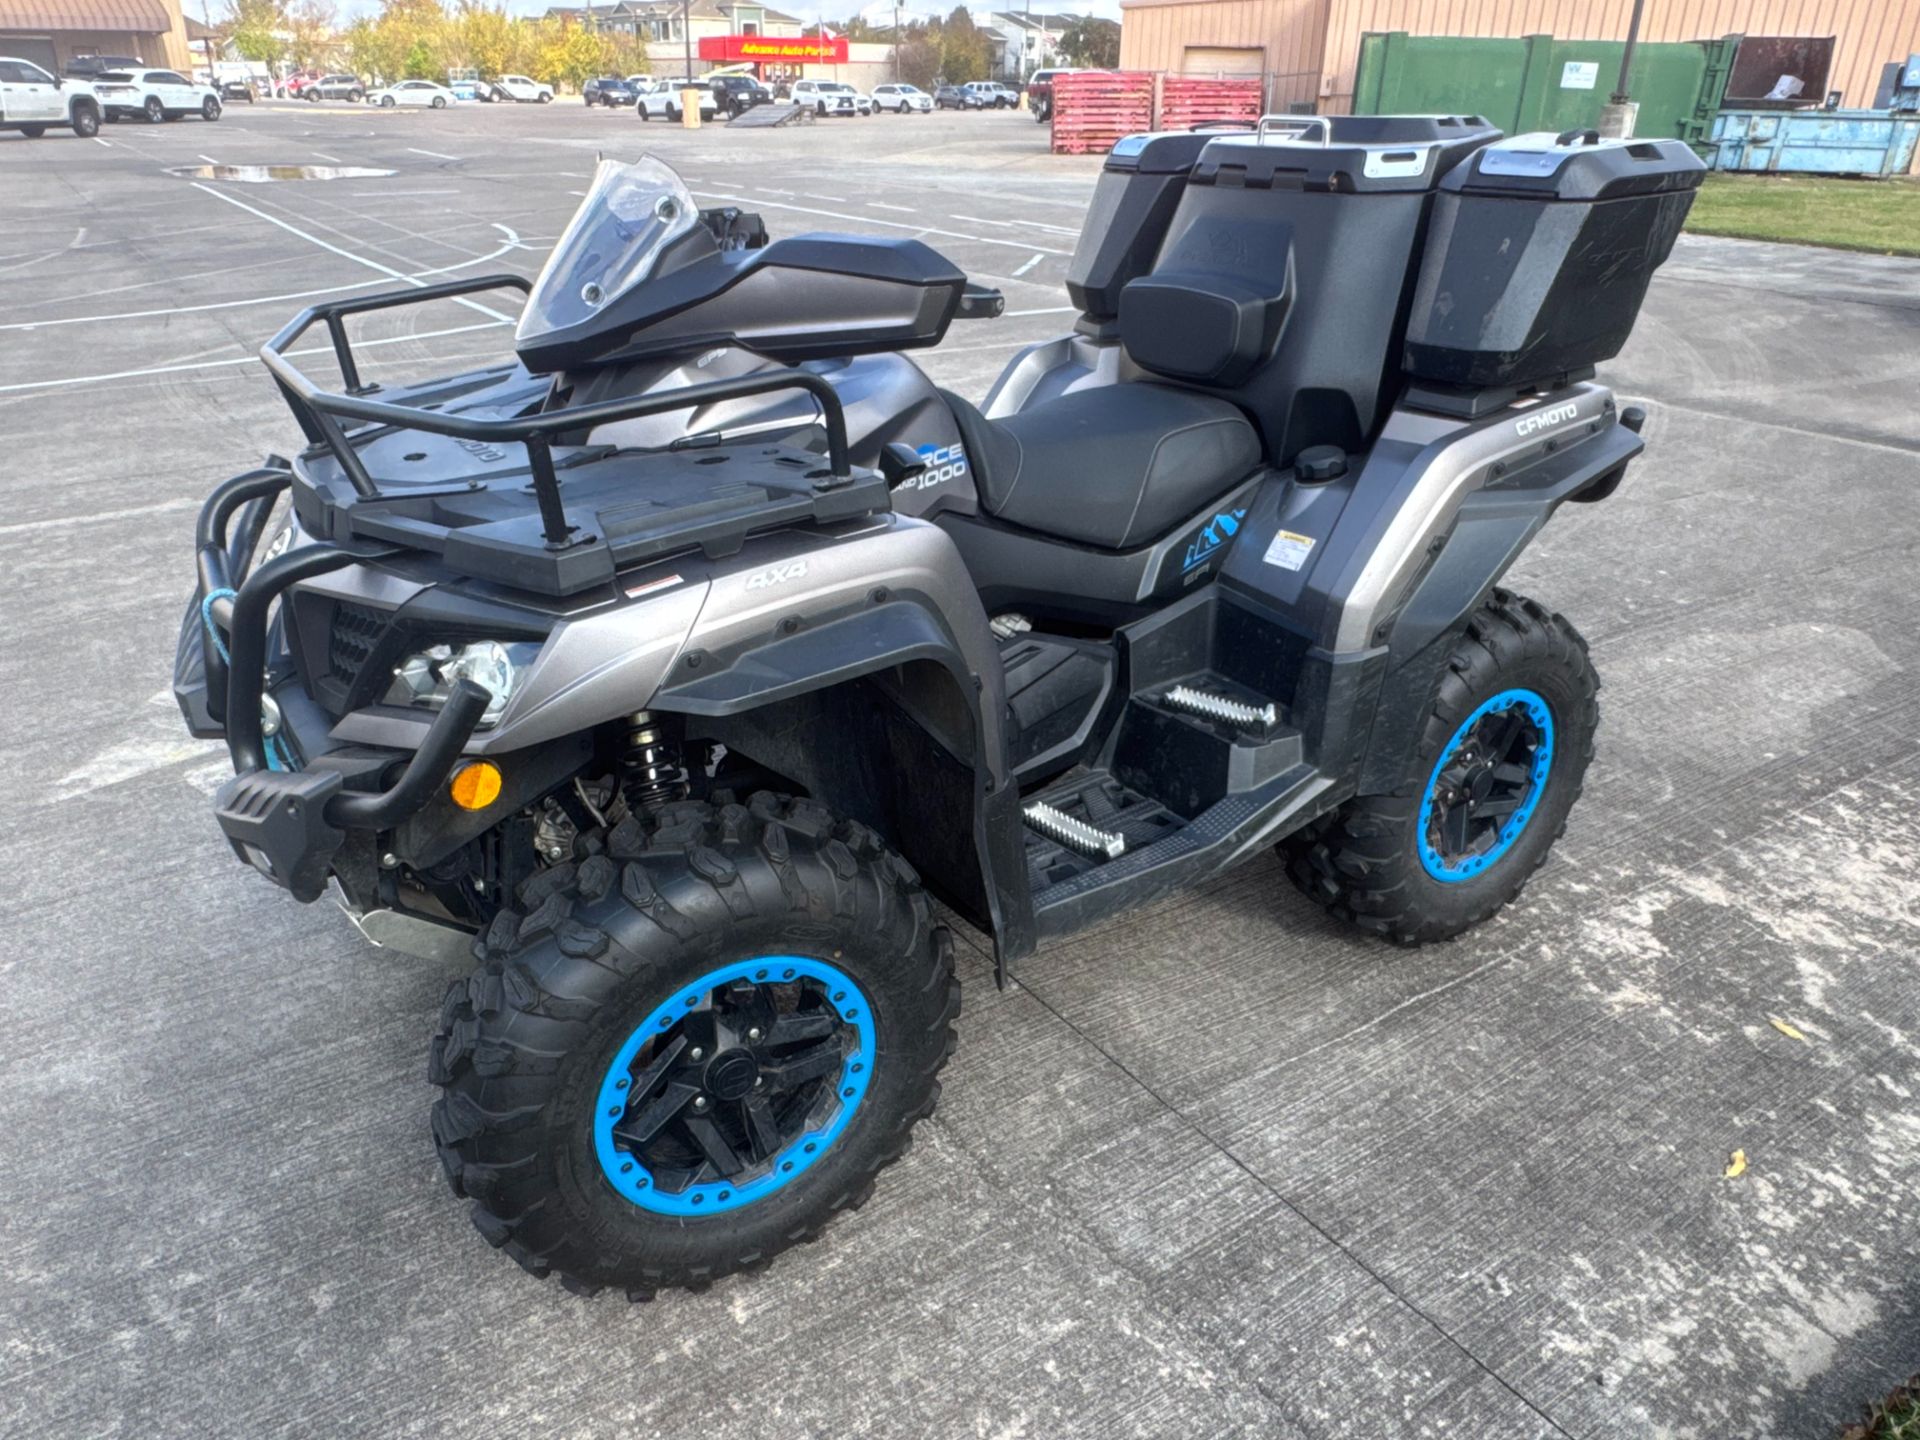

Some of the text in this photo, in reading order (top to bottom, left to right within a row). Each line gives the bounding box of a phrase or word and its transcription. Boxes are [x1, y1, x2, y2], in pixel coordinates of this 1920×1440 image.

[741, 43, 779, 55] Advance
[780, 45, 804, 56] Auto
[1515, 403, 1577, 436] CFMOTO
[921, 443, 962, 468] RCE
[918, 461, 966, 490] 1000
